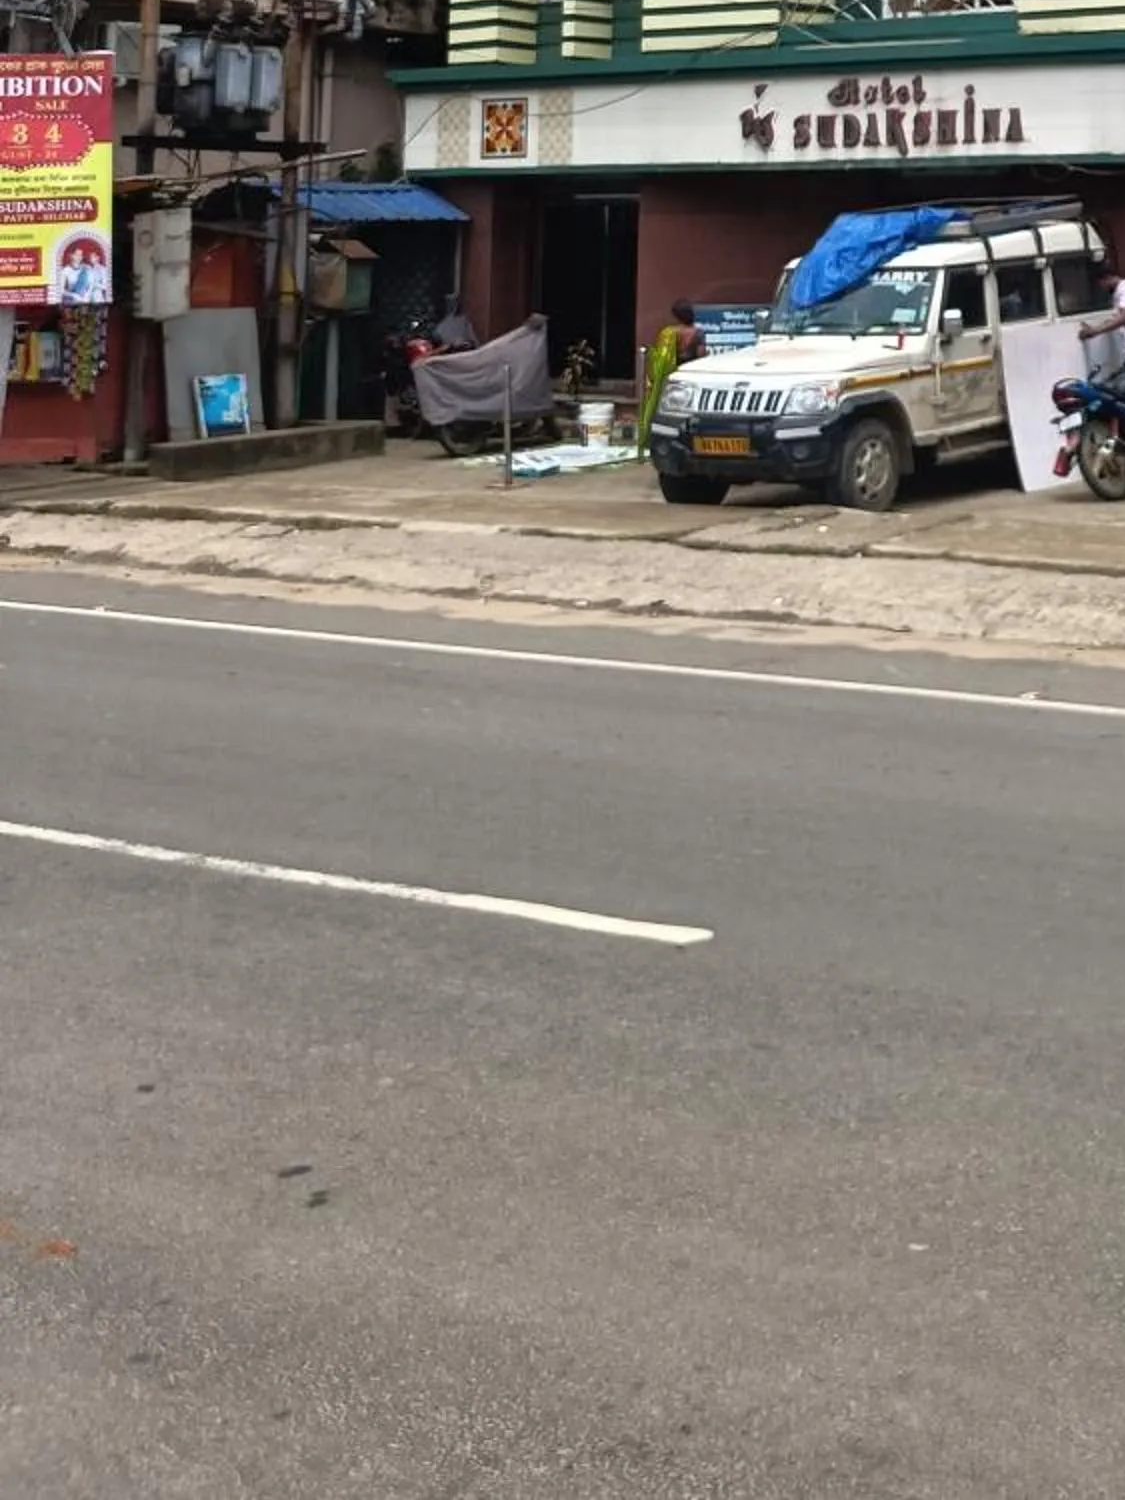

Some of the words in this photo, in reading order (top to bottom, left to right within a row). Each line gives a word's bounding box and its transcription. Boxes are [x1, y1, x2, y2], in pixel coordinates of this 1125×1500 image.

[827, 74, 927, 107] Hotel
[35, 100, 69, 111] SALE
[44, 121, 62, 143] 4
